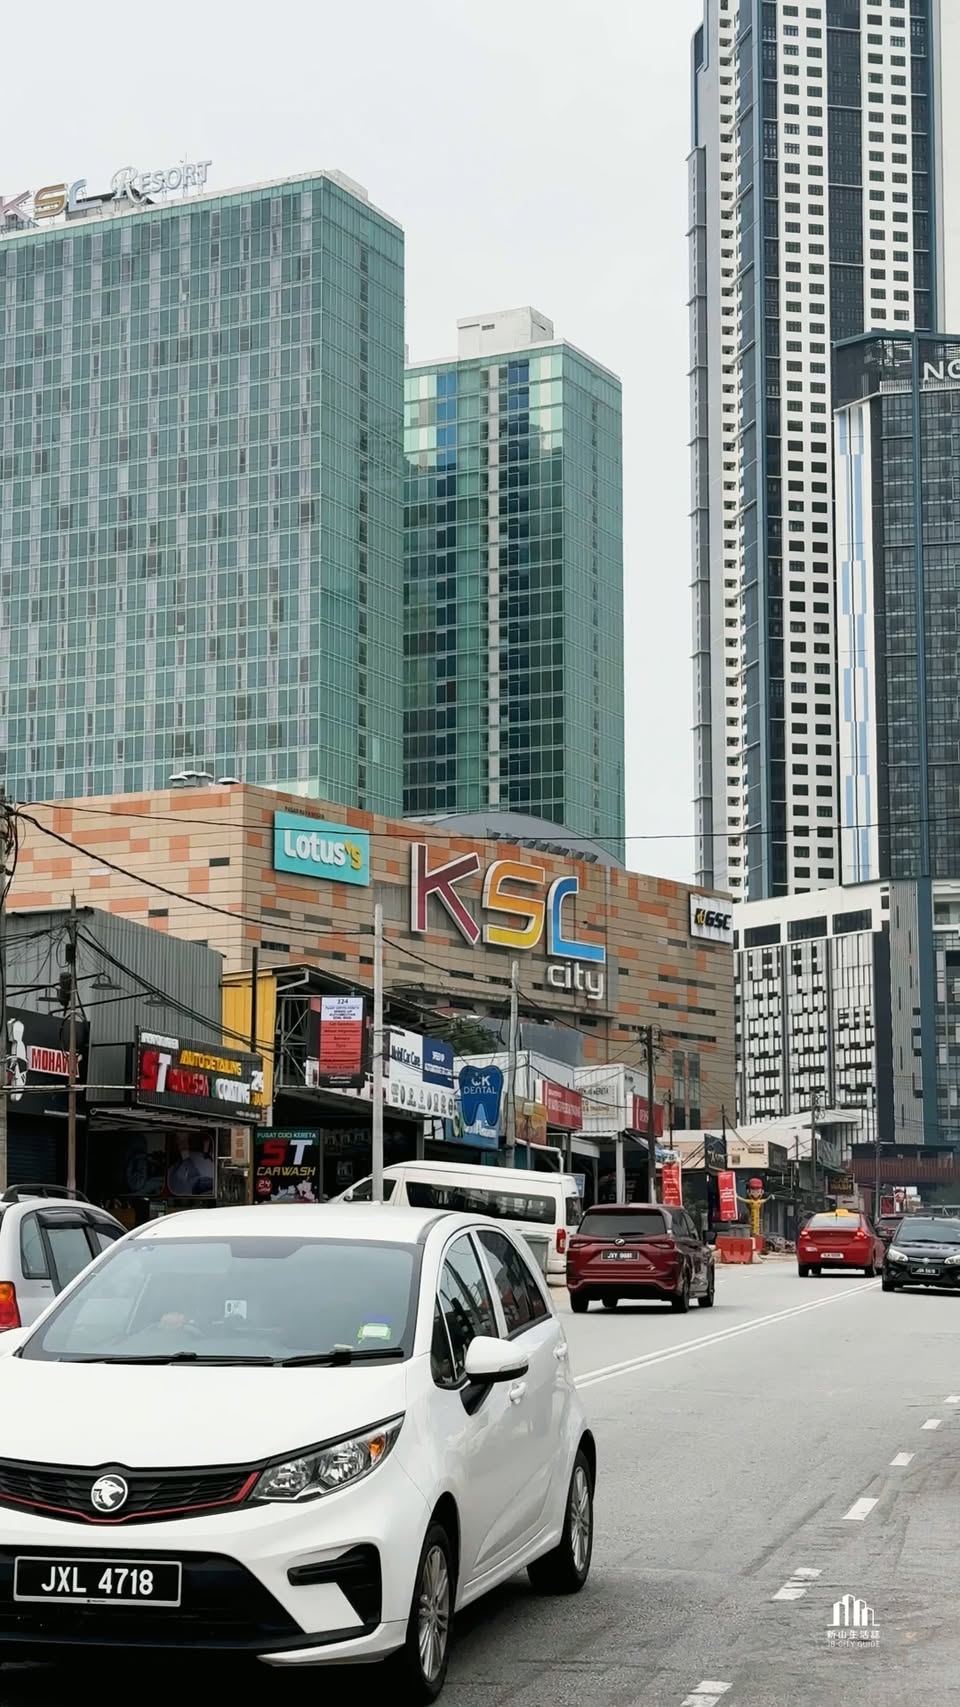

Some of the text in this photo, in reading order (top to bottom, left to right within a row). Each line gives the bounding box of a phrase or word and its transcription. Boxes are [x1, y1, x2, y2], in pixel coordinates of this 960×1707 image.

[284, 827, 362, 871] Lotus's
[411, 842, 606, 963] KSL
[705, 910, 732, 930] GSC
[547, 962, 605, 999] city
[31, 1047, 78, 1077] MOHAW
[463, 1086, 497, 1095] DENTAL
[277, 1131, 293, 1139] CUCI
[260, 1138, 314, 1166] ST
[41, 1566, 154, 1595] JXL 4718
